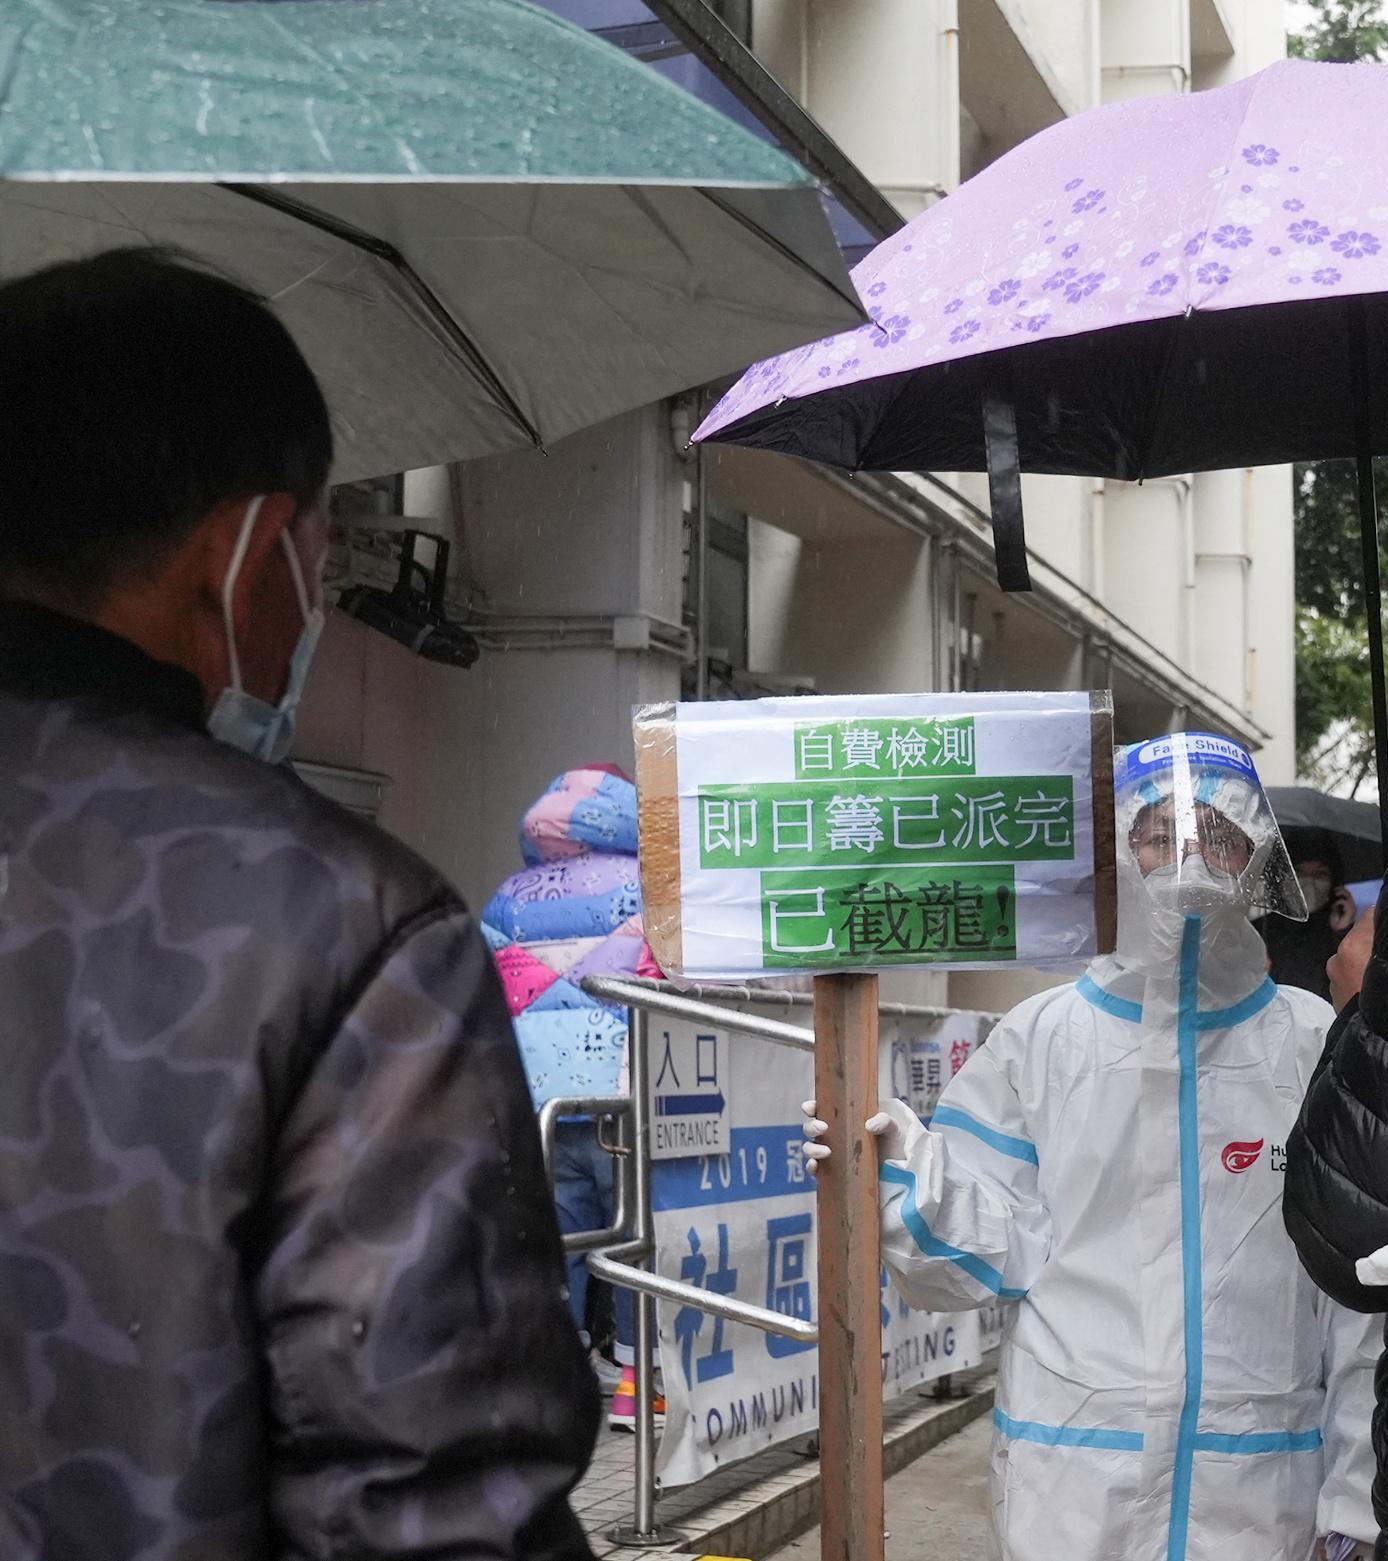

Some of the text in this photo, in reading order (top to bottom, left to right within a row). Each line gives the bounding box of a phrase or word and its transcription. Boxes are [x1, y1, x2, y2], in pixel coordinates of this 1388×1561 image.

[800, 725, 975, 772] 自費檢測
[1195, 739, 1239, 758] Shield
[703, 790, 1072, 857] 即日籌已派完
[764, 880, 1014, 955] 已截龍!
[656, 1031, 717, 1089] 入口
[657, 1120, 719, 1149] ENTRANCE
[700, 1146, 768, 1191] 2019
